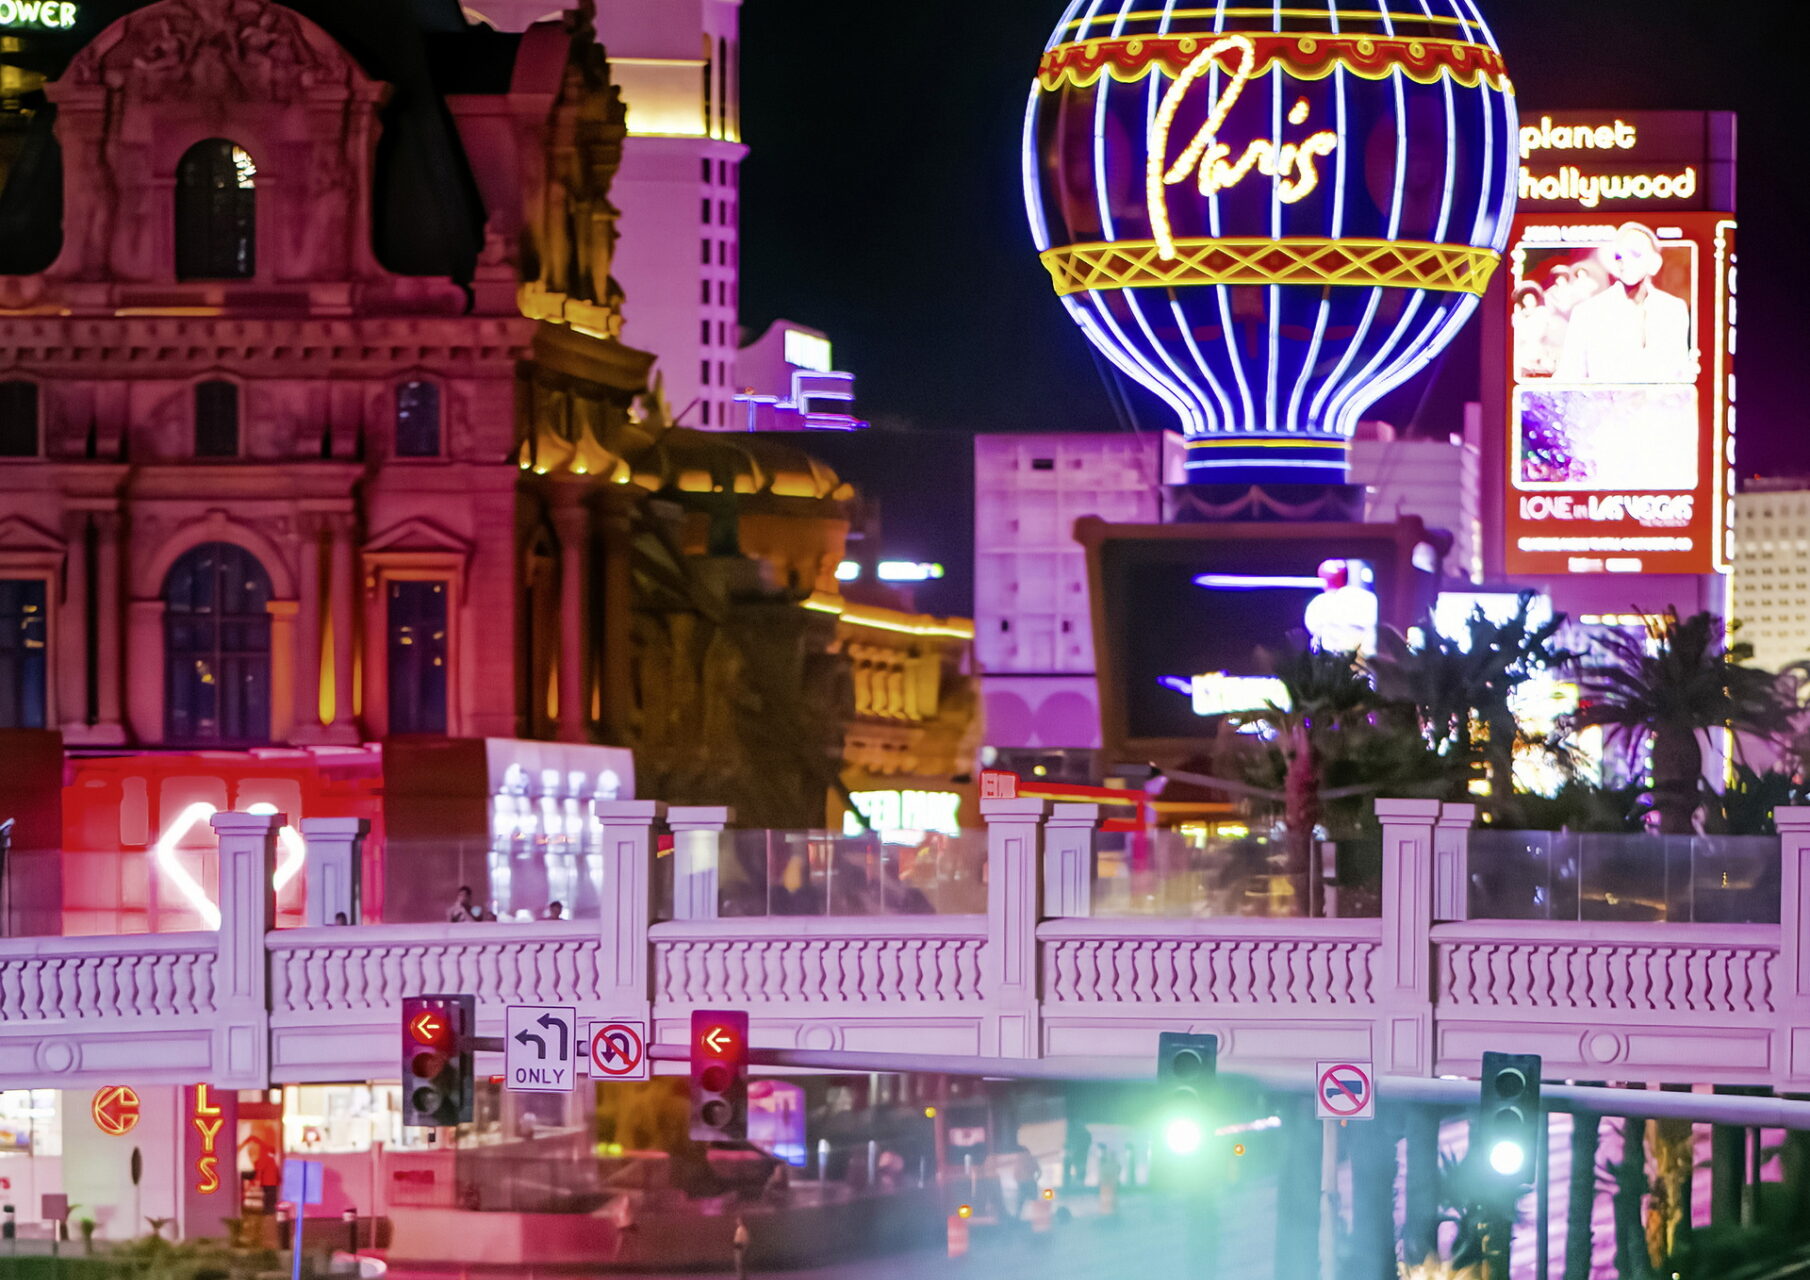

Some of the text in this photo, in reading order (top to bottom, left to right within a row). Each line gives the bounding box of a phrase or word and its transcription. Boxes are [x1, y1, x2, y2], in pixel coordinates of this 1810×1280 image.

[0, 0, 77, 28] OWER
[1147, 34, 1337, 261] Paris
[1519, 116, 1636, 159] planet
[1518, 166, 1696, 208] hollywood
[1520, 496, 1573, 520] LOVE
[516, 1067, 565, 1084] ONLY
